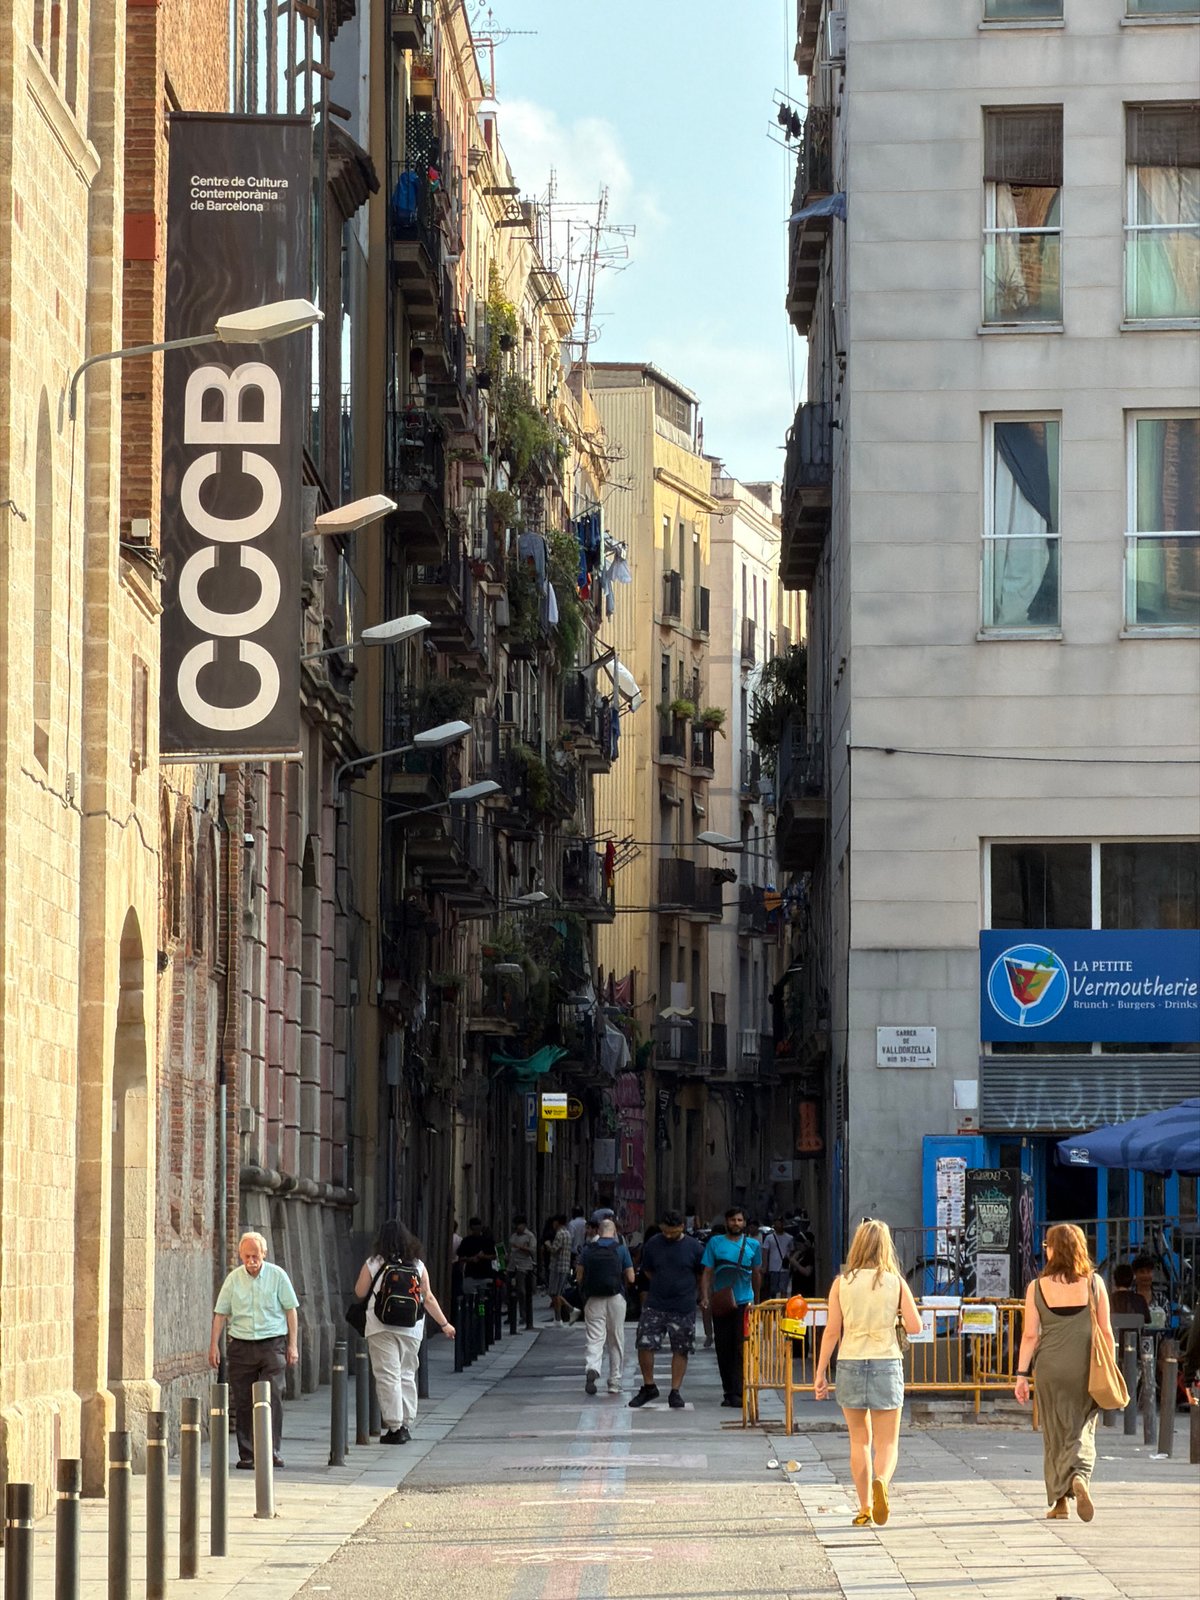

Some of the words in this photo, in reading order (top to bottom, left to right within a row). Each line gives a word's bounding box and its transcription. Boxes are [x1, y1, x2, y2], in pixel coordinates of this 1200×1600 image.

[190, 175, 230, 187] Centre
[230, 176, 246, 187] de
[246, 177, 289, 188] Cultura
[190, 188, 278, 201] Contemporània
[190, 200, 205, 211] de
[206, 201, 264, 212] Barcelona
[177, 362, 282, 731] CCCB
[1073, 960, 1089, 972] LA
[1092, 960, 1133, 972] PETITE
[1073, 975, 1198, 996] Vermoutherie
[1073, 1000, 1109, 1009] Brunch
[1117, 1000, 1156, 1011] Burgers
[1164, 1000, 1198, 1009] Drinks
[882, 1046, 932, 1054] VALLDONZELLA
[978, 1204, 1009, 1214] TATTOOS
